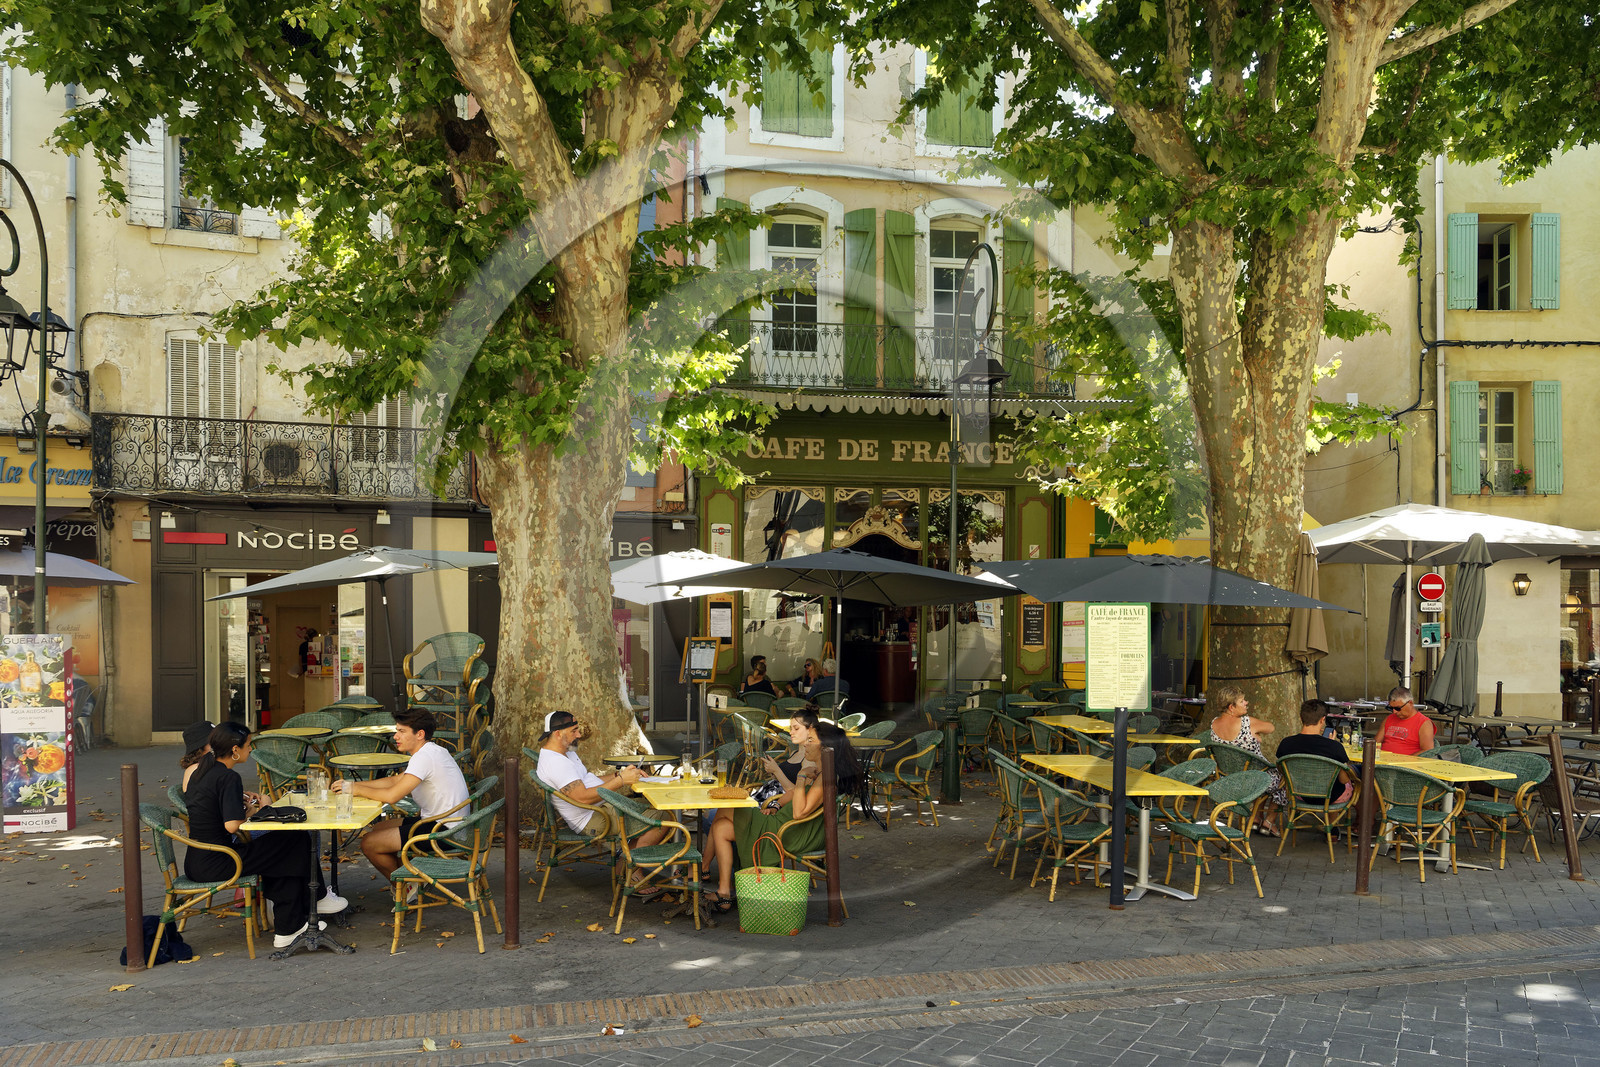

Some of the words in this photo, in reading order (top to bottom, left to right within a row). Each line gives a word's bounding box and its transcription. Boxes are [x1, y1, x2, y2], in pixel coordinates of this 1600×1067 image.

[746, 437, 825, 461] CAFE
[838, 439, 879, 462] DE
[891, 440, 1014, 465] FRANCE
[1109, 608, 1118, 616] de
[1119, 608, 1146, 616] FRANCE
[3, 637, 61, 645] GUERLAIN
